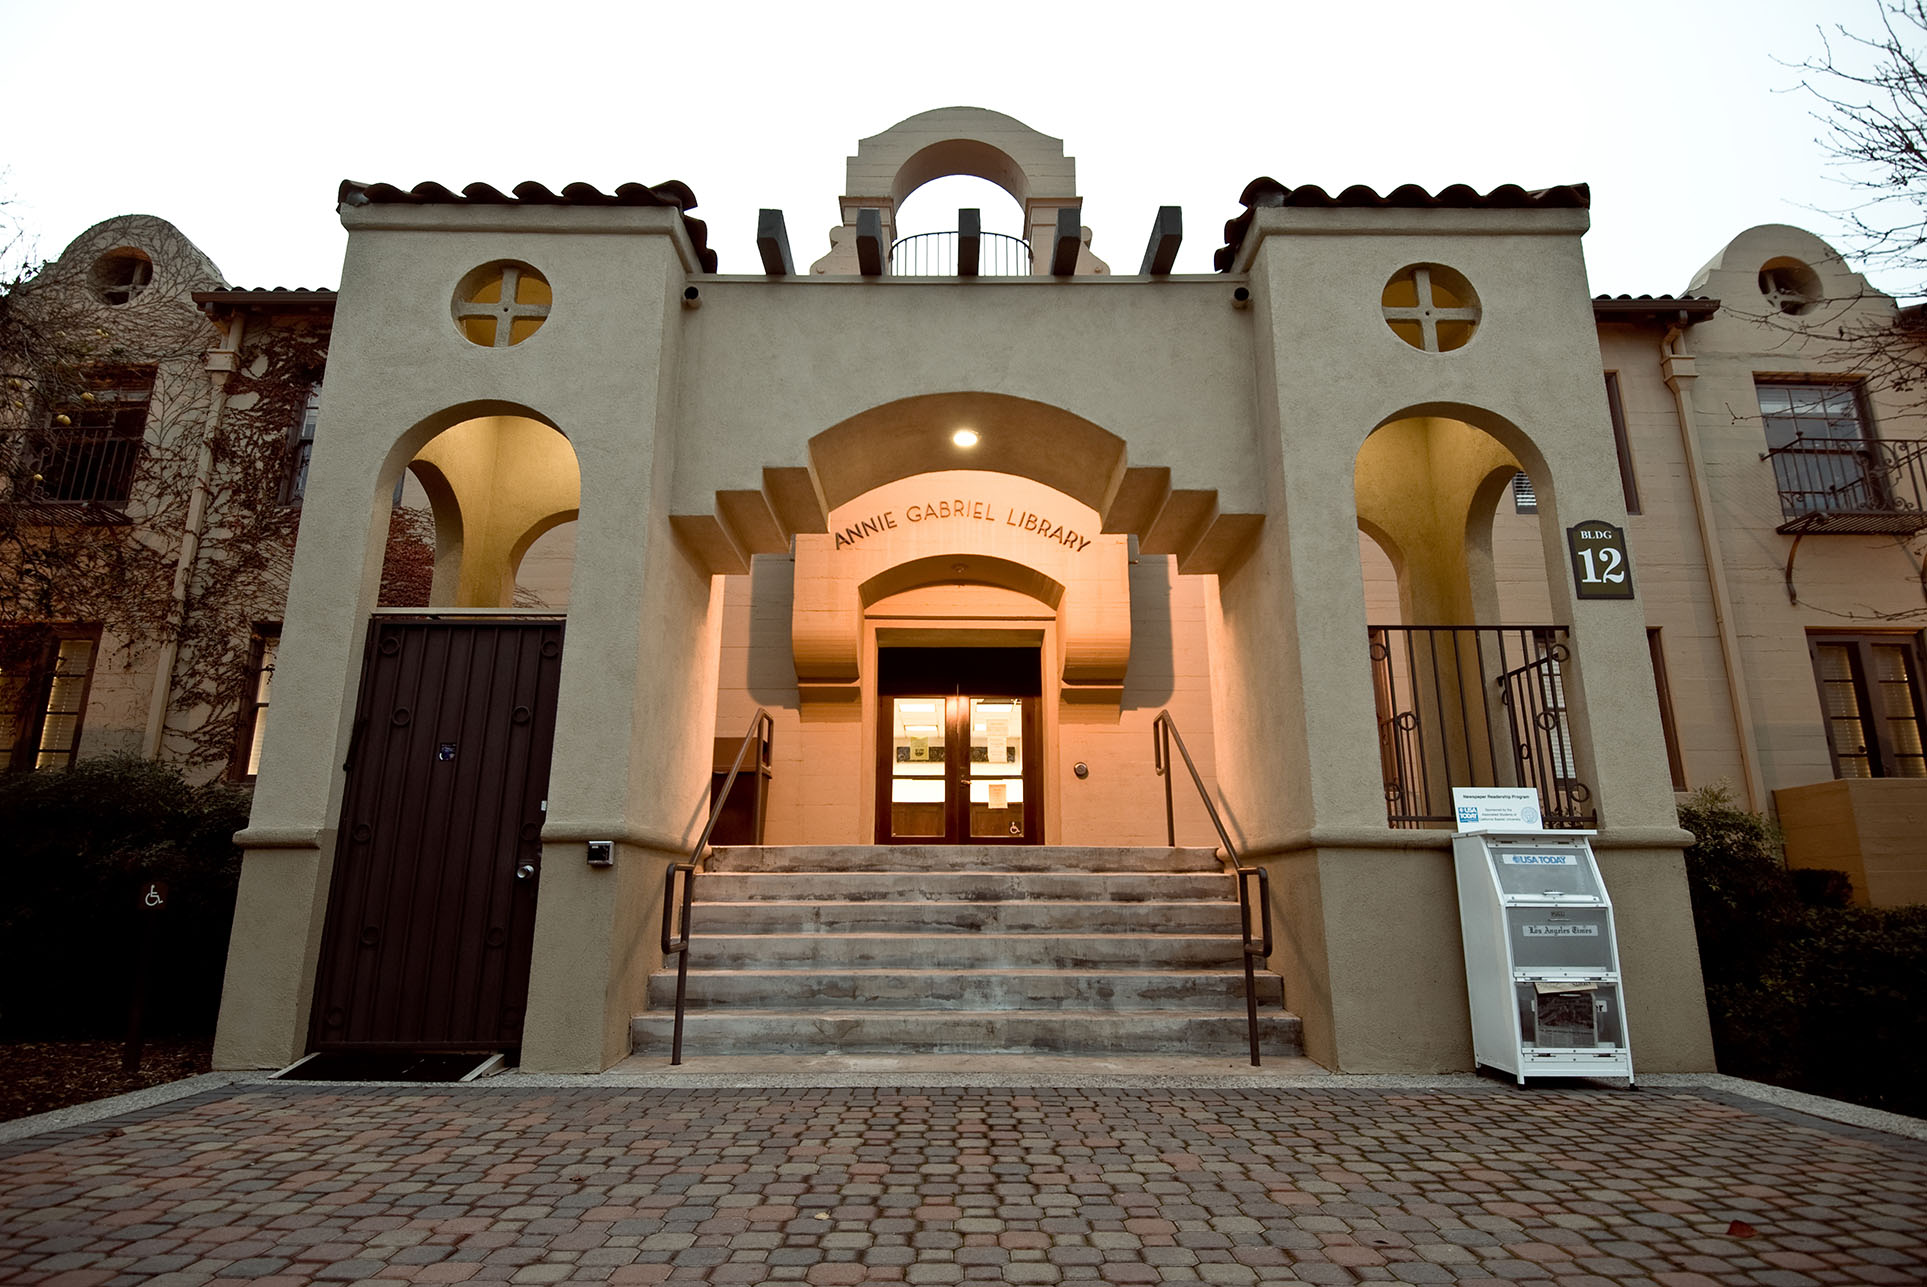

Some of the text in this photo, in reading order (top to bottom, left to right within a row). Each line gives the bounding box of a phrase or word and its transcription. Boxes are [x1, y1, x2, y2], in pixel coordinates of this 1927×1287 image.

[834, 499, 1092, 552] ANNIE GABRIEL LIBRARY
[1580, 530, 1612, 539] BLDG
[1578, 547, 1625, 584] 12
[1519, 856, 1566, 864] USA TODAY
[1528, 926, 1592, 936] Los Angeles Times
